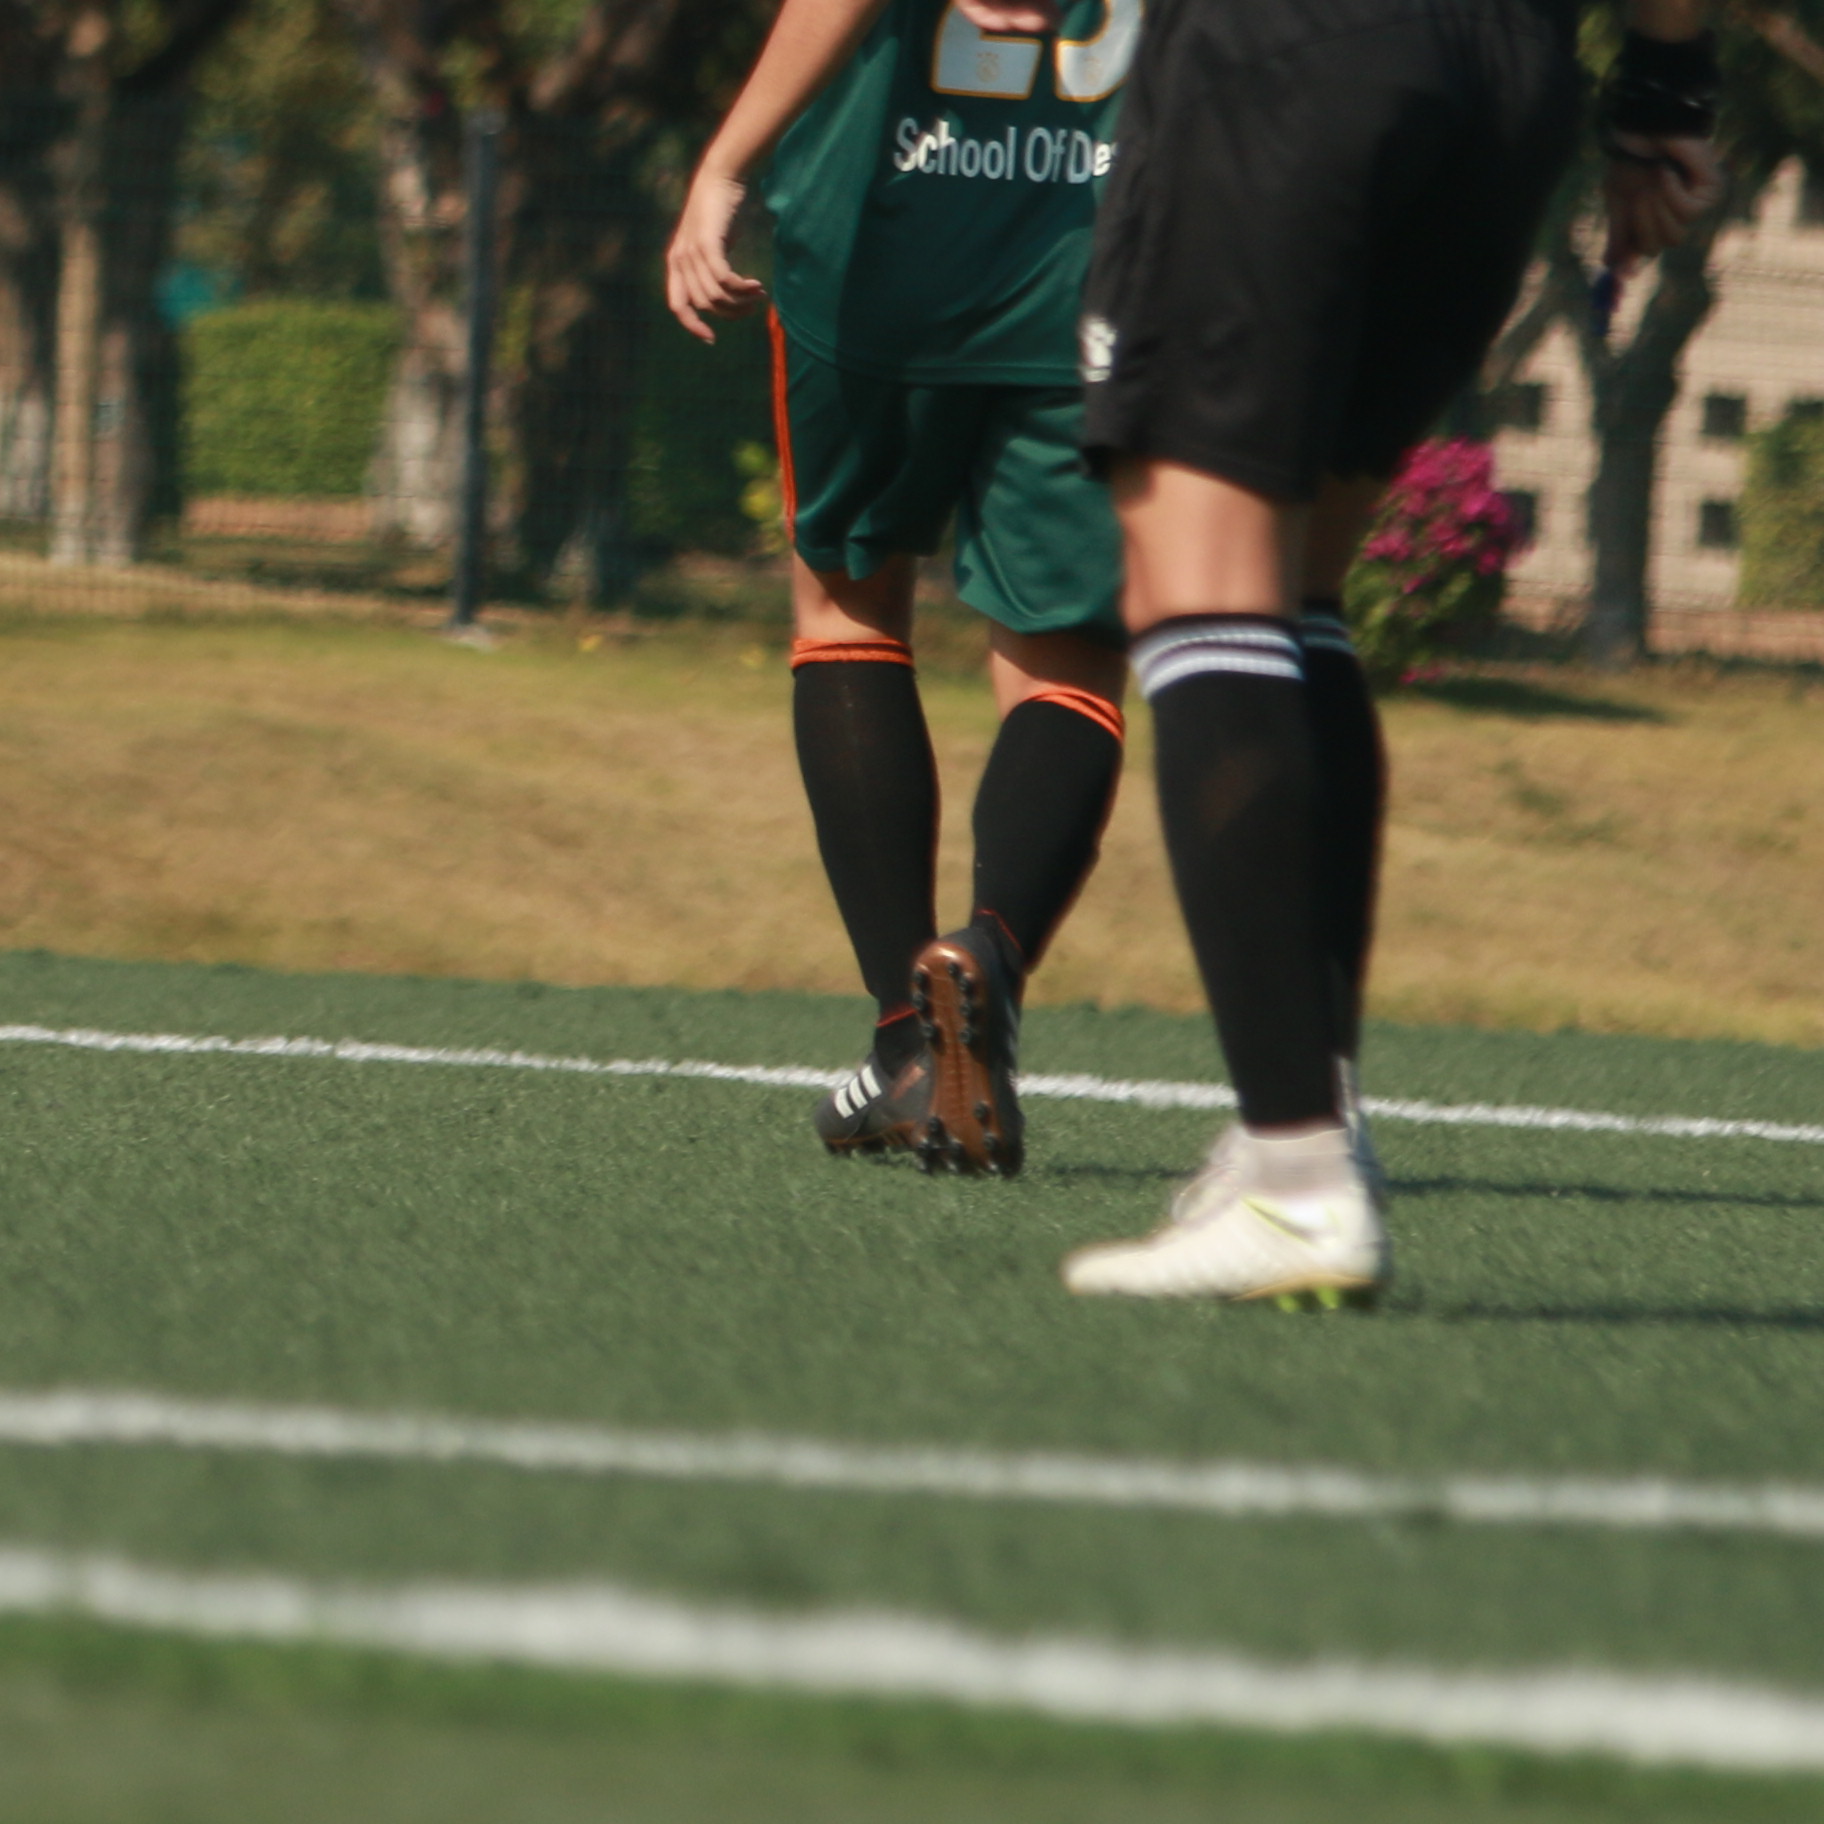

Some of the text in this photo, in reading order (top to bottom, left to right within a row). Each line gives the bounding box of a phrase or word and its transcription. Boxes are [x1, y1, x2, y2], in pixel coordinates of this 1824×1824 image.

[893, 117, 1118, 184] School Of De
